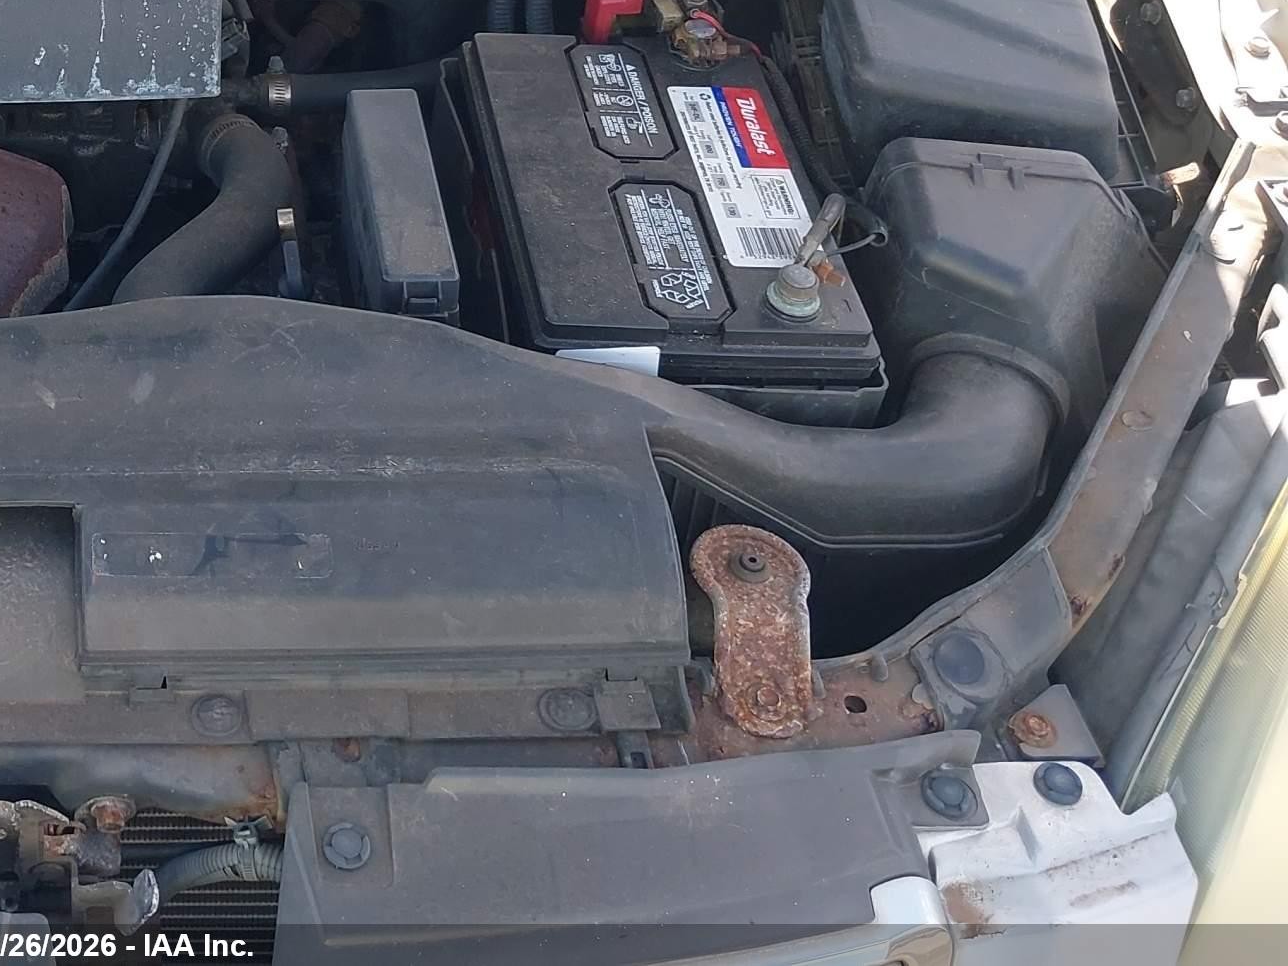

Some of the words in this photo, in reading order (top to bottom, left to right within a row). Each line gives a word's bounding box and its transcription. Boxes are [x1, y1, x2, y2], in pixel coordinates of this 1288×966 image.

[628, 72, 646, 101] DANGER
[640, 106, 659, 134] POISON
[719, 101, 733, 127] PROVEN
[736, 97, 776, 156] Duralast
